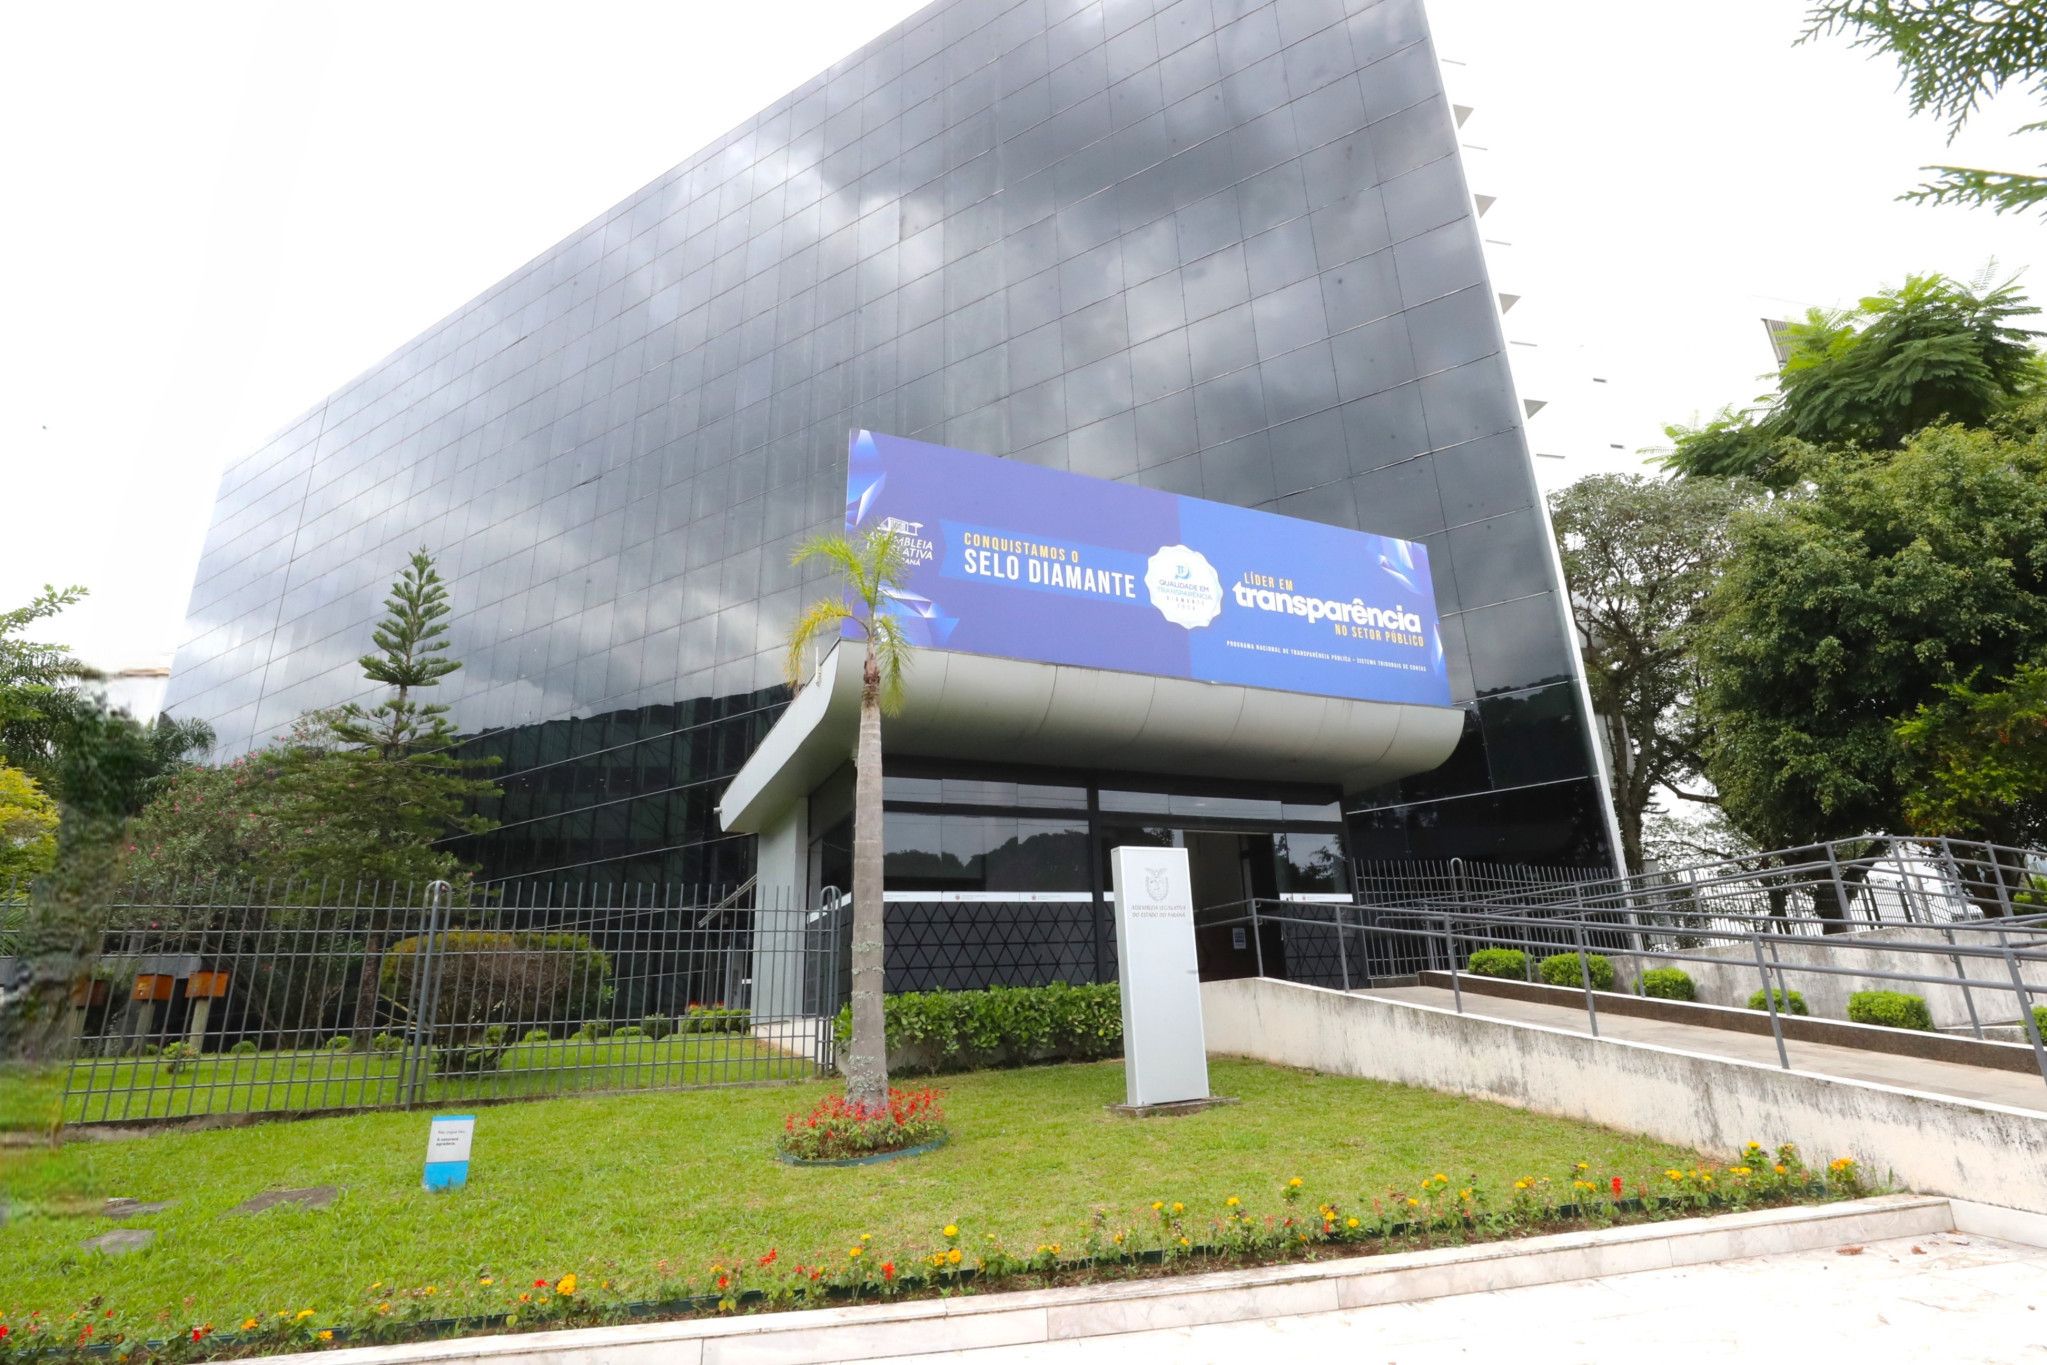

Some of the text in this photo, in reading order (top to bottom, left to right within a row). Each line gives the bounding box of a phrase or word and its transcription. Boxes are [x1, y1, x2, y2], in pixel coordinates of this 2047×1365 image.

[964, 532, 1079, 563] CONQUISTAMOS O
[964, 548, 1136, 598] SELO DIAMANTE
[1159, 579, 1209, 593] QUALIDADE EM
[1244, 571, 1294, 592] LÍDER EM
[1232, 580, 1422, 633] transparência
[1334, 624, 1425, 647] NO SETOR PÚBLICO
[1226, 640, 1255, 650] PROGRAMA
[1256, 644, 1281, 653] NACIONAL
[1291, 649, 1330, 660] TRANSPARÊNCIA
[1331, 653, 1351, 662] PÚBLICA
[1356, 657, 1376, 666] SISTEMA
[1378, 660, 1402, 669] TRIBUNAIS
